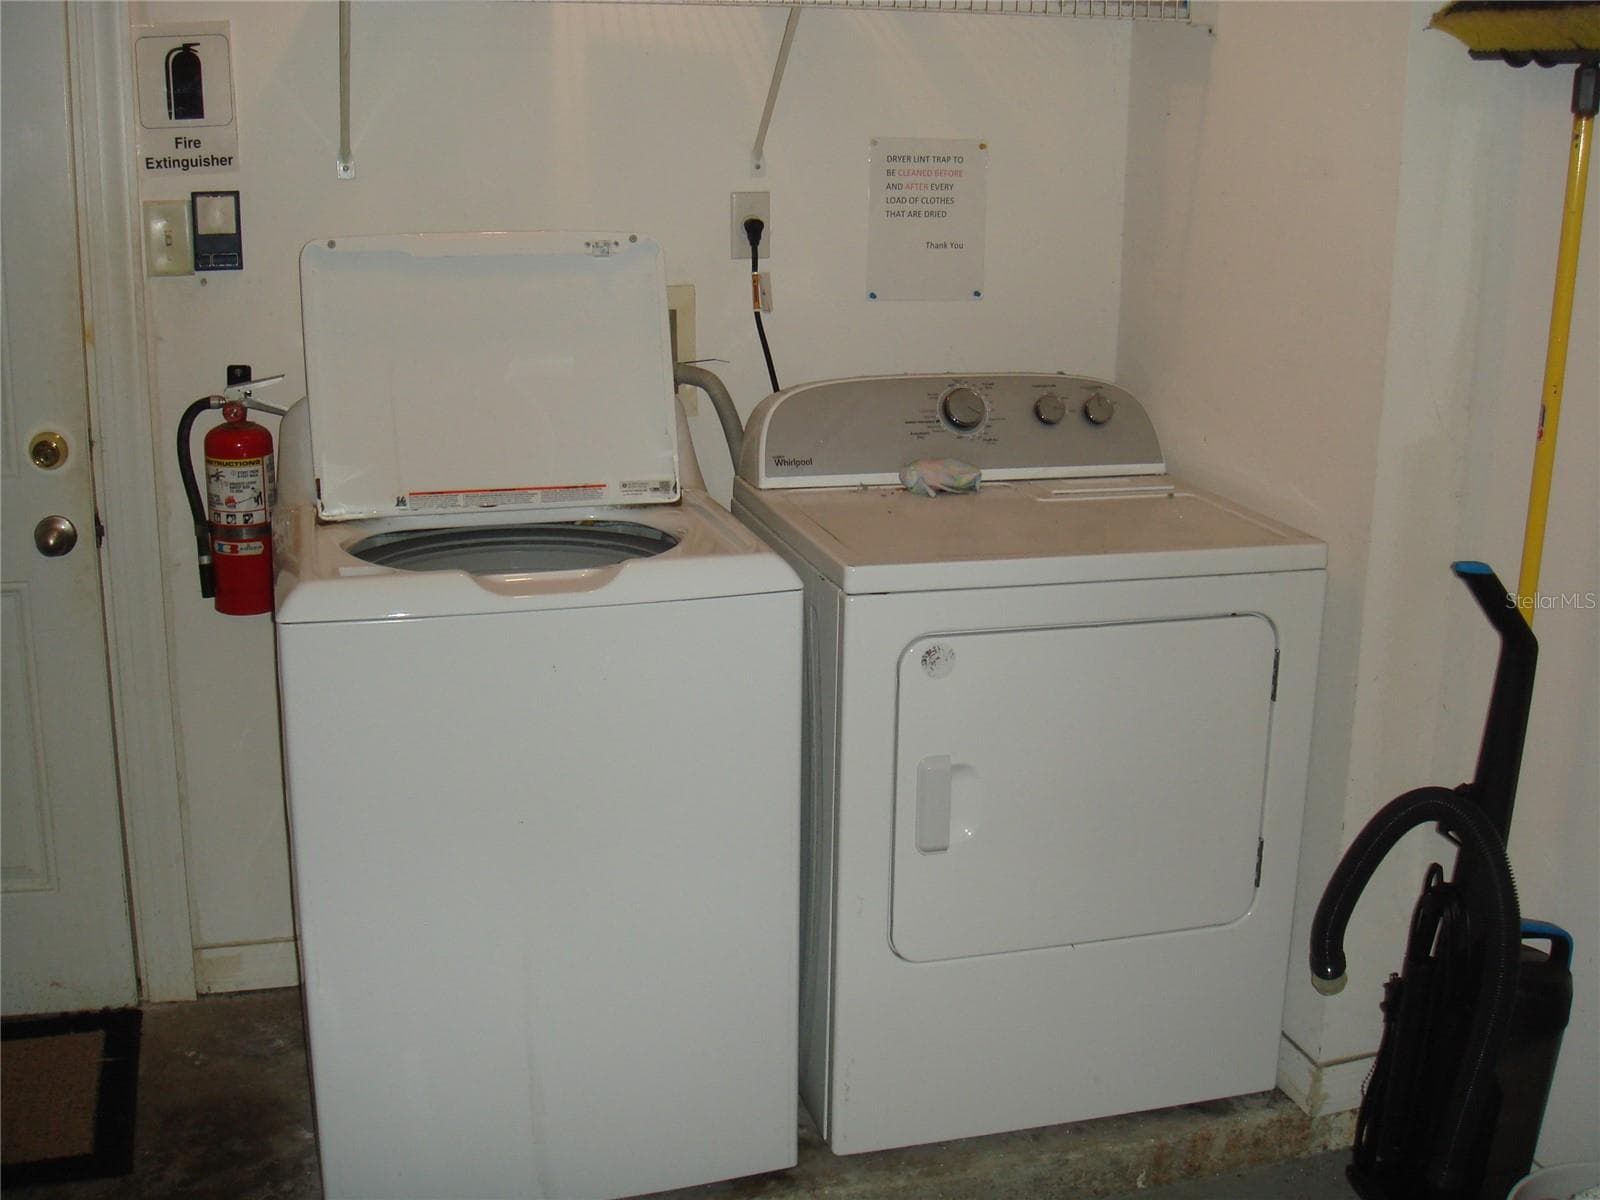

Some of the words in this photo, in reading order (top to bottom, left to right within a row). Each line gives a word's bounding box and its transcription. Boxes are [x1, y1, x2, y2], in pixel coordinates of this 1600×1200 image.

[174, 136, 202, 150] Fire
[145, 154, 234, 171] Extinguisher
[886, 155, 912, 164] DRYER
[913, 155, 930, 164] LINT
[932, 155, 952, 164] TRAP
[953, 155, 964, 164] TO
[886, 168, 896, 177] BE
[897, 168, 933, 177] CLEANED
[934, 168, 963, 177] BEFORE
[886, 183, 903, 191] AND
[904, 183, 929, 191] AFTER
[930, 183, 954, 191] EVERY
[886, 196, 907, 205] LOAD
[908, 196, 919, 205] OF
[920, 196, 955, 205] CLOTHES
[886, 210, 906, 218] THAT
[907, 210, 922, 218] ARE
[924, 210, 947, 218] DRIED
[926, 241, 948, 249] Thank
[949, 241, 964, 249] You
[774, 457, 814, 469] Whirlpool
